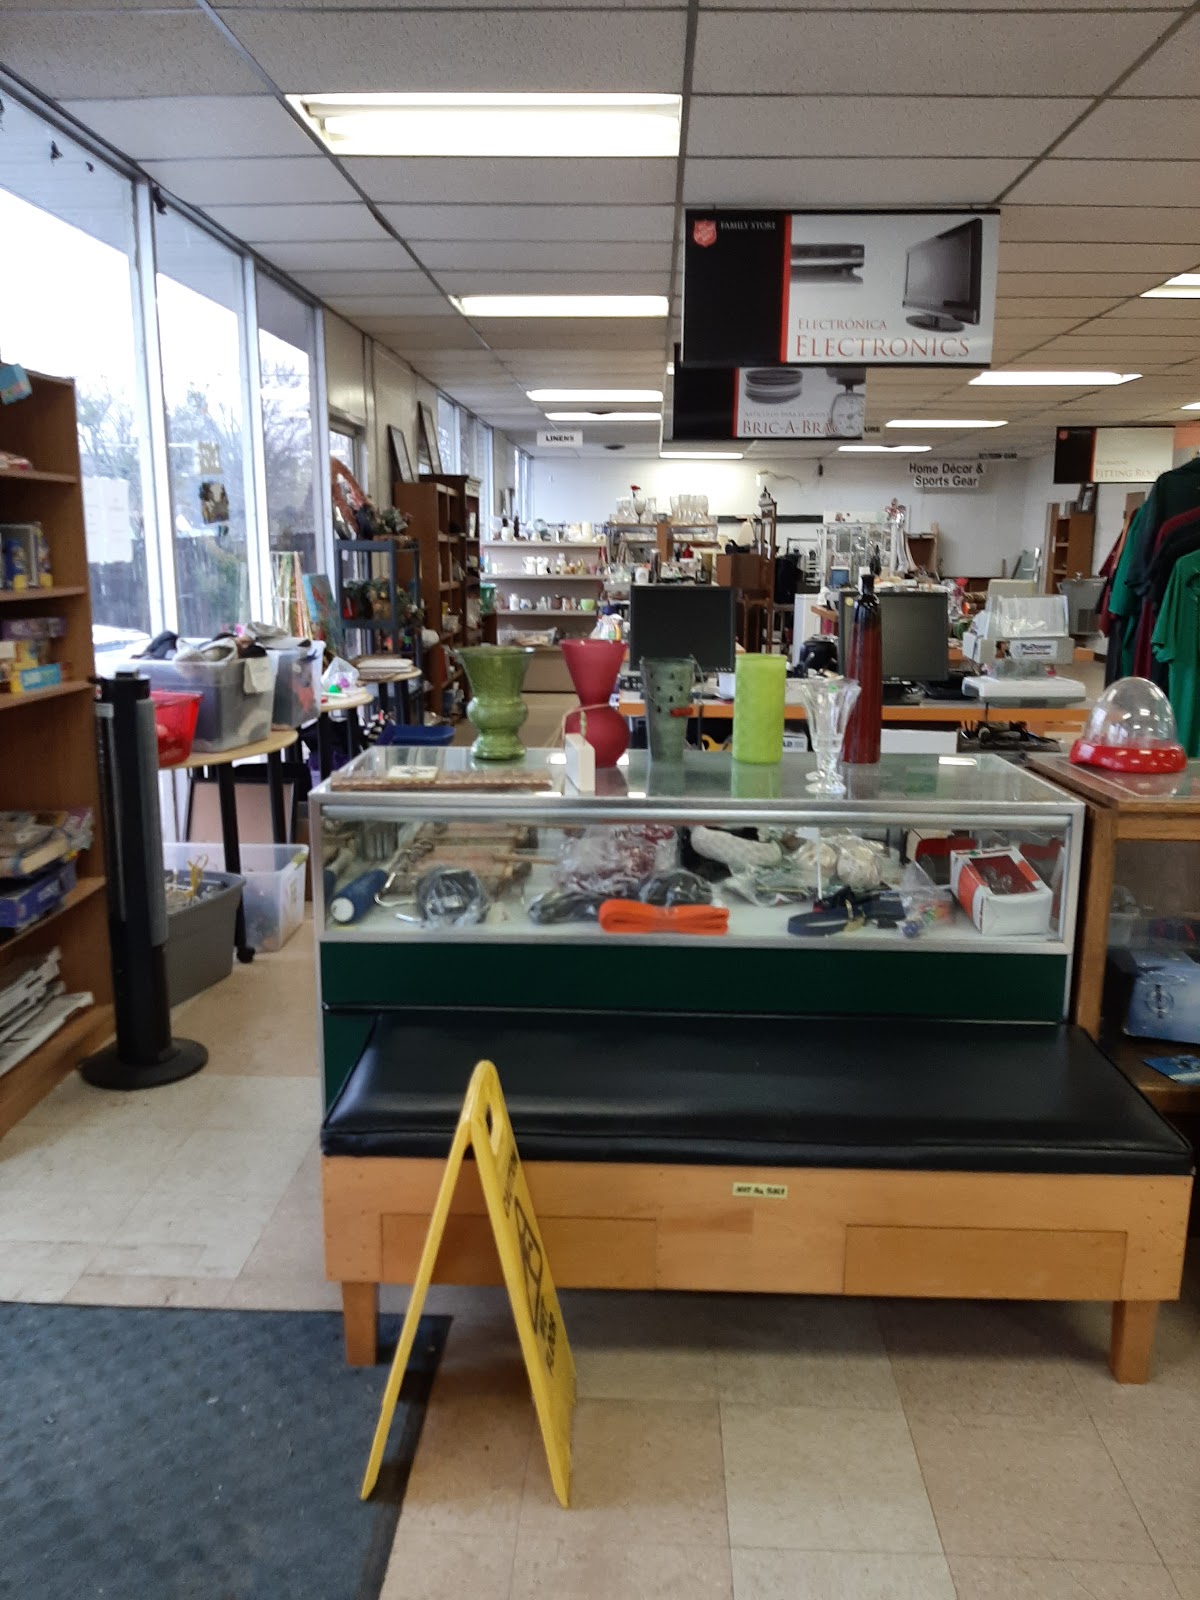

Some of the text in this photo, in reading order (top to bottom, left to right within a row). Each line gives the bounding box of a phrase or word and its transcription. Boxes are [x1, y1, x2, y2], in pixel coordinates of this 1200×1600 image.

[720, 221, 776, 230] FAMILY STORE
[796, 334, 970, 358] ELECTRONICS
[909, 462, 938, 474] Home
[976, 463, 984, 473] &
[915, 475, 977, 486] Sports Gear
